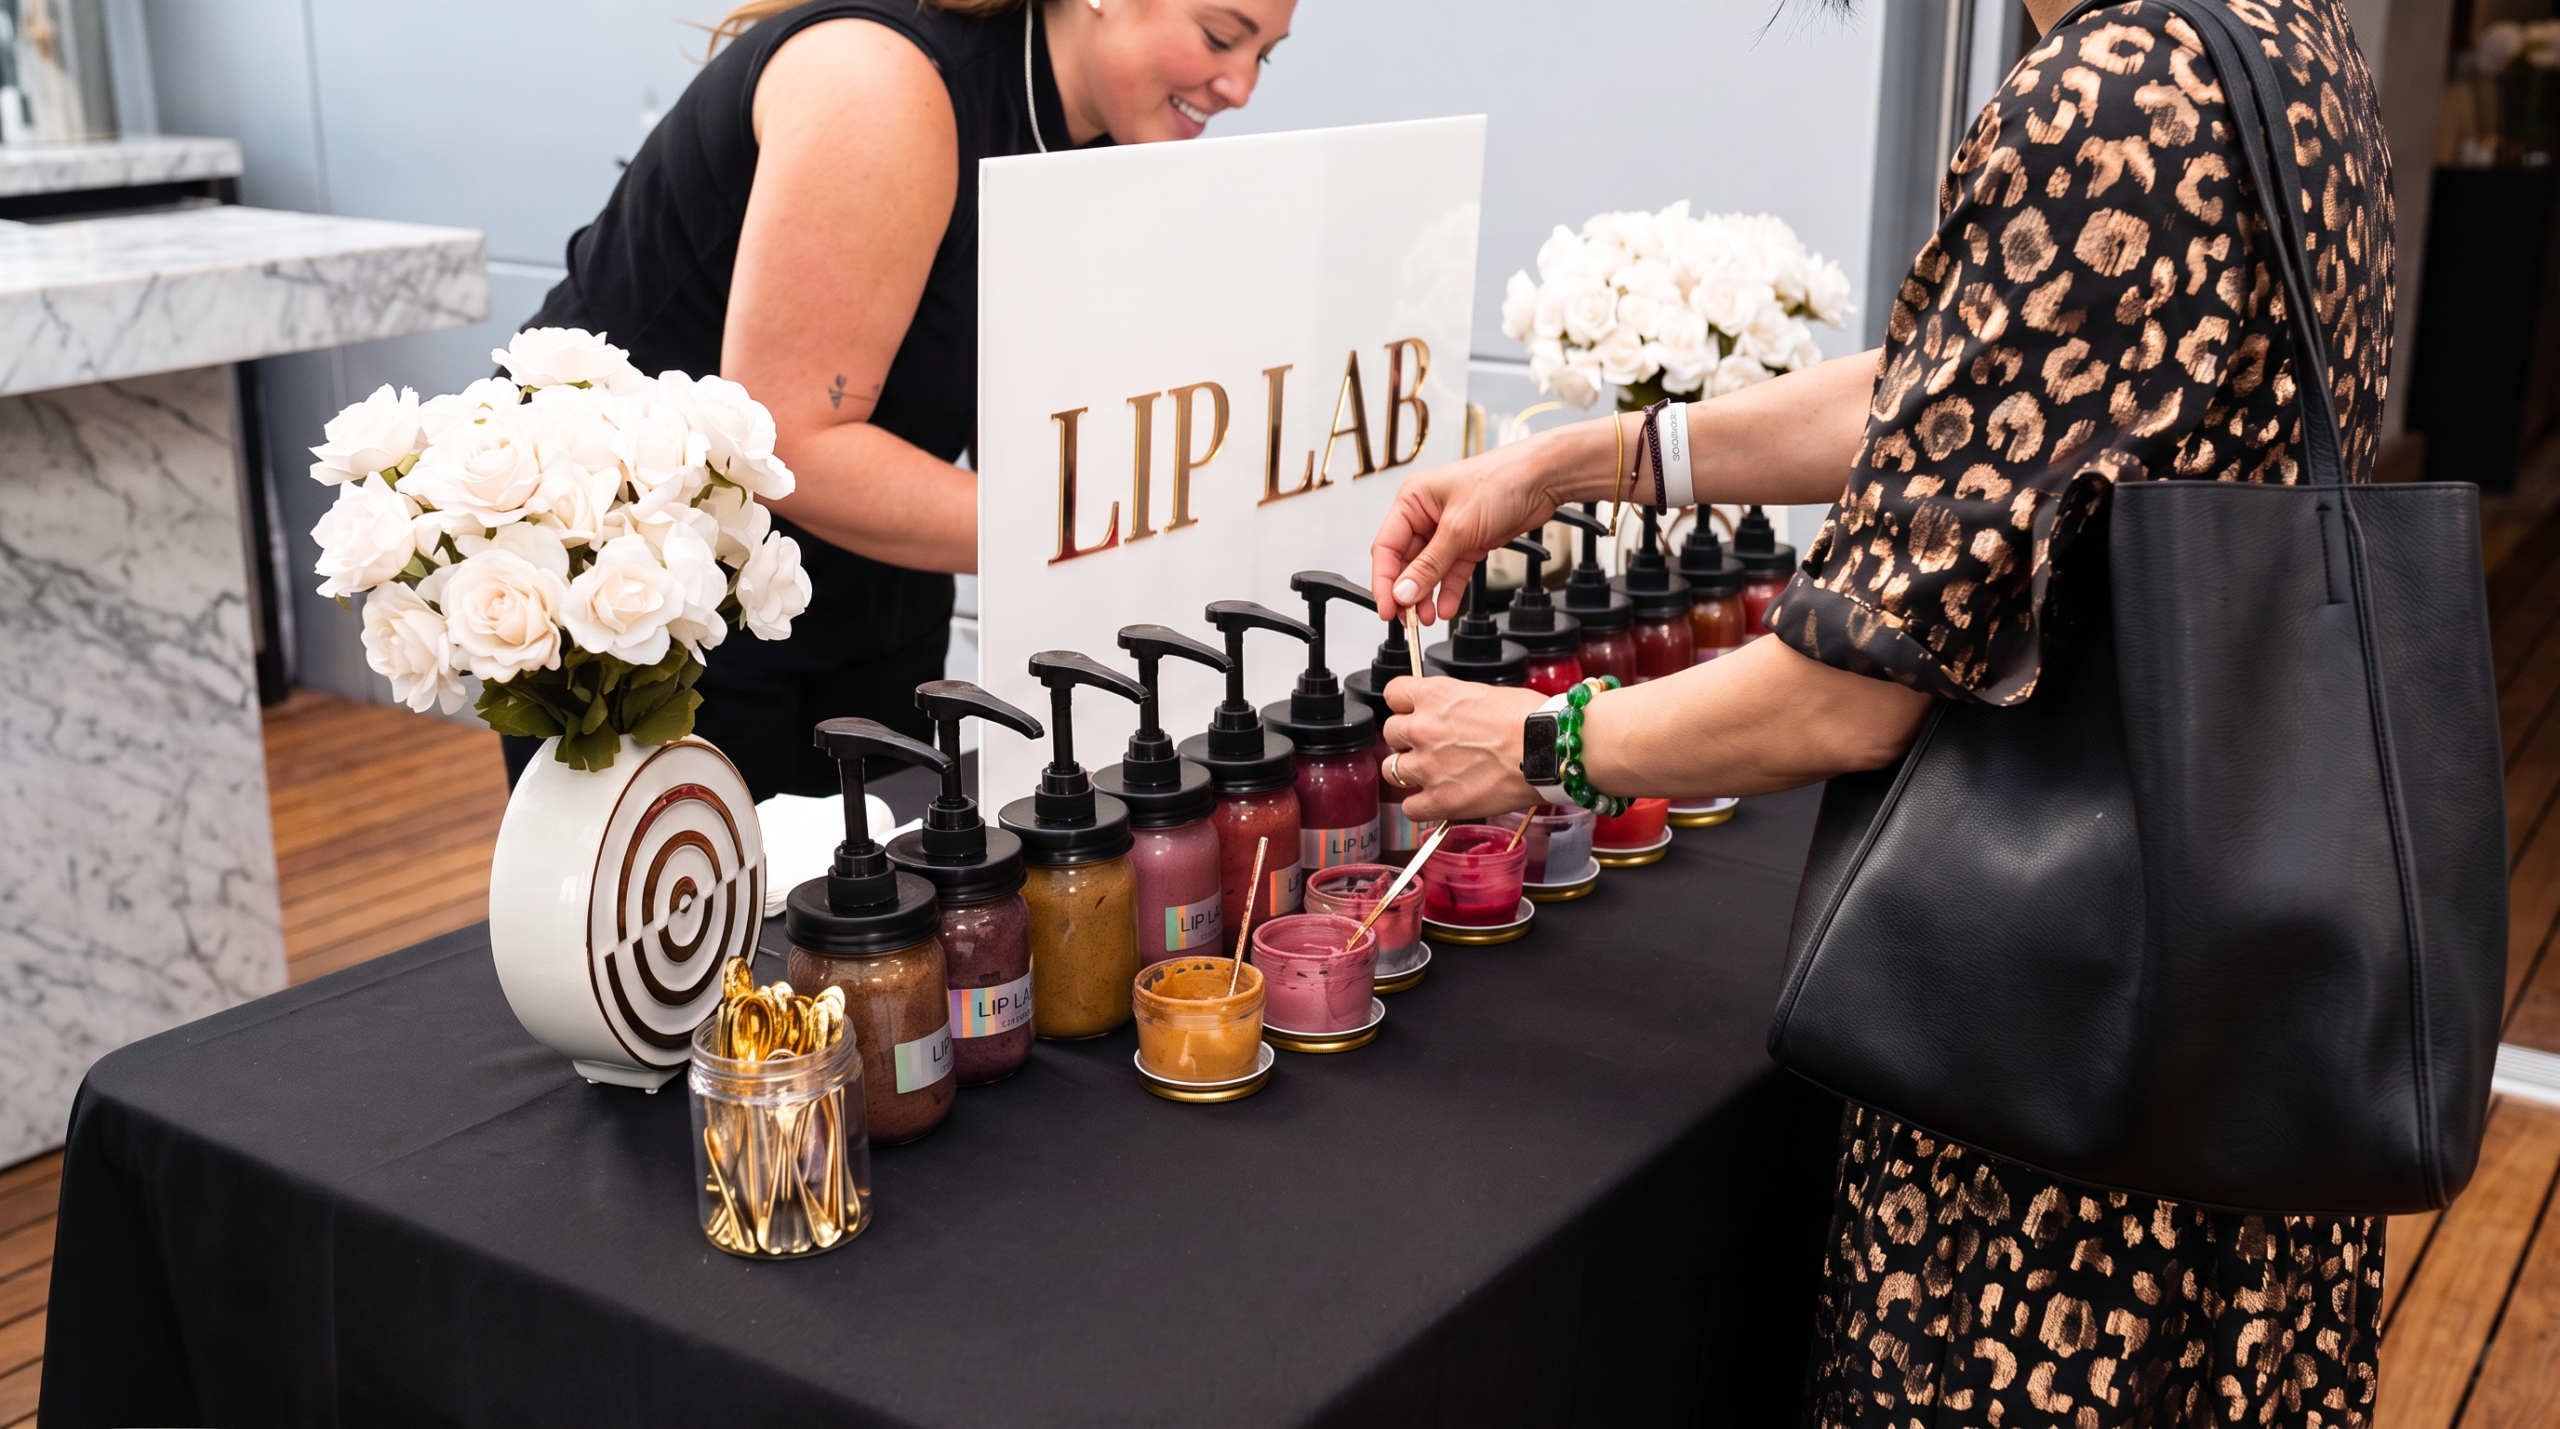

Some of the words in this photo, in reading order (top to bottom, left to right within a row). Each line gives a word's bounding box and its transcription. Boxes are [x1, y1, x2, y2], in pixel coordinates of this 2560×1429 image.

[1047, 380, 1230, 567] LIP
[1257, 336, 1431, 508] LAB
[1332, 838, 1357, 854] LIP
[1181, 913, 1204, 932] LIP
[979, 997, 1009, 1018] LIP
[933, 1036, 950, 1063] LIP
